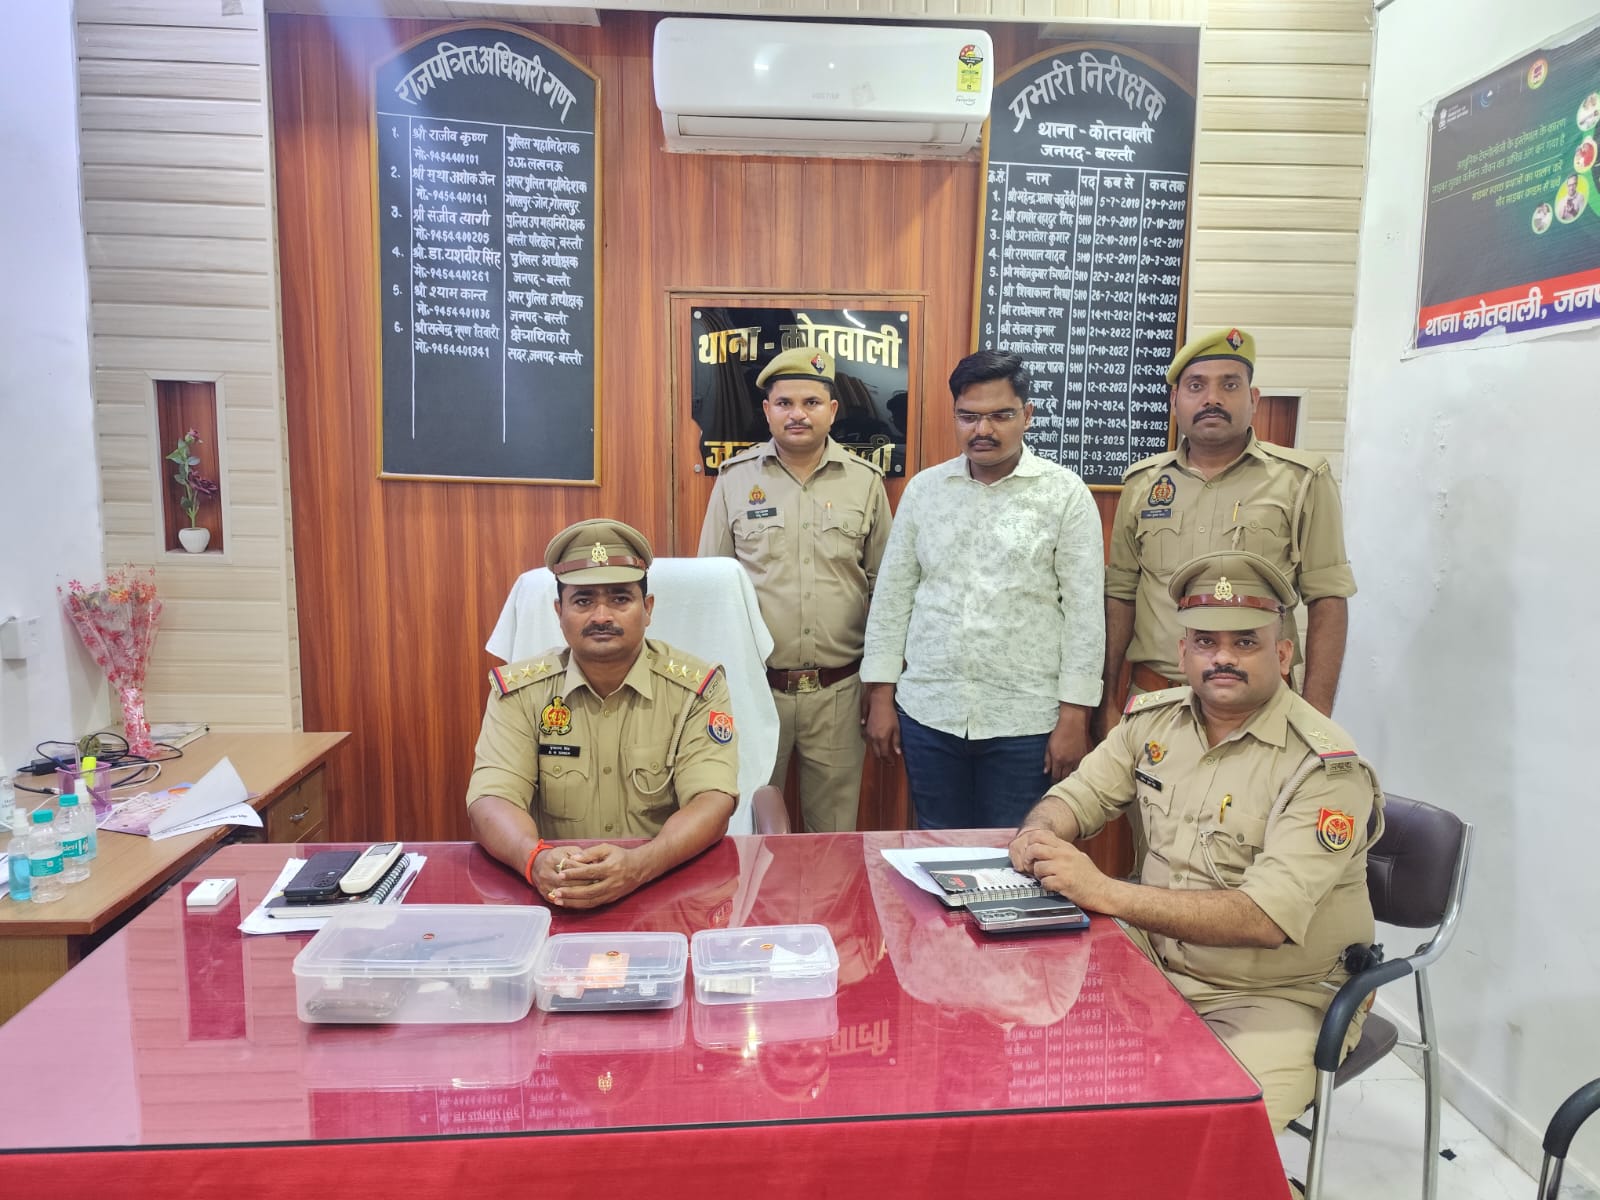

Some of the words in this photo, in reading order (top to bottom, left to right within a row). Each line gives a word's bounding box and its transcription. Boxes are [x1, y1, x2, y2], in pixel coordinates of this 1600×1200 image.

[394, 42, 478, 104] राजपत्रित
[478, 42, 546, 96] अधिकारी
[543, 72, 576, 124] गण
[1008, 59, 1074, 133] प्रभारी
[1078, 52, 1166, 122] निरीक्षक
[412, 124, 426, 141] श्री
[429, 126, 458, 142] राजीव
[460, 132, 489, 146] कृष्ण
[1038, 120, 1078, 140] थाना
[1089, 120, 1155, 144] कोतवाली
[506, 133, 532, 152] पुलिस
[533, 136, 580, 155] महानिदेशक
[1041, 143, 1086, 162] जनपद
[1094, 145, 1136, 162] बस्ती
[391, 166, 400, 178] 2.
[412, 164, 426, 180] श्री
[450, 169, 478, 185] अशोक
[479, 170, 496, 186] जैन
[528, 158, 564, 172] लखनऊ
[1026, 172, 1052, 186] नाम
[1080, 176, 1096, 190] पद
[1104, 177, 1122, 188] कब
[1124, 173, 1135, 190] से
[1149, 179, 1169, 192] कब
[1170, 180, 1186, 192] तक
[1008, 187, 1018, 203] श्री
[1080, 195, 1093, 206] SHO
[1100, 196, 1140, 208] 5-7-2018
[1145, 198, 1186, 211] 29-9-2019
[413, 204, 426, 222] श्री
[427, 205, 458, 224] संजीव
[460, 209, 492, 226] त्यागी
[992, 208, 1002, 220] 2.
[1006, 207, 1016, 222] श्री
[1079, 215, 1092, 226] SHO
[1097, 215, 1138, 228] 29-9-2019
[990, 228, 1000, 240] 3.
[1006, 226, 1018, 242] श्री
[1048, 232, 1071, 246] कुमार
[1078, 234, 1092, 244] SHO
[1143, 236, 1184, 248] 6-12-2019
[392, 246, 404, 258] 4.
[482, 247, 502, 270] सिंह
[510, 250, 540, 268] पुलिस
[988, 248, 1000, 260] 4.
[1004, 244, 1016, 260] श्री
[1076, 253, 1090, 263] SHO
[1094, 253, 1136, 265] 15-12-2019
[1140, 254, 1180, 267] 20-3-2021
[989, 266, 998, 278] 5.
[1003, 264, 1013, 278] श्री
[1075, 270, 1088, 280] SHO
[1093, 271, 1134, 284] 22-3-2021
[1139, 274, 1180, 286] 26-7-2021
[393, 284, 402, 296] 5.
[414, 281, 428, 298] श्री
[428, 286, 458, 299] श्याम
[460, 288, 488, 302] कान्त
[988, 284, 997, 296] 6.
[1002, 282, 1014, 298] श्री
[1074, 289, 1088, 300] SHO
[1092, 290, 1133, 304] 26-7-2021
[1138, 292, 1178, 306] 14-11-2021
[987, 304, 995, 316] 7.
[1002, 302, 1012, 316] श्री
[1048, 306, 1064, 318] राय
[1072, 308, 1086, 318] SHO
[1091, 309, 1132, 320] 14-11-2021
[1136, 311, 1176, 323] 21-4-2022
[394, 320, 404, 332] 6.
[986, 322, 994, 334] 8.
[1000, 320, 1012, 335] श्री
[1034, 325, 1056, 339] कुमार
[1072, 326, 1086, 336] SHO
[1090, 326, 1131, 338] 21-4-2022
[1425, 312, 1460, 336] थाना
[698, 326, 761, 364] थाना
[779, 313, 902, 368] कोतवाली
[1070, 344, 1084, 354] SHO
[1088, 344, 1128, 356] 17-10-2022
[1136, 347, 1171, 358] 1-7-2023
[1070, 363, 1083, 374] SHO
[1088, 362, 1126, 374] 1-7-2023
[1068, 382, 1082, 392] SHO
[1088, 382, 1128, 392] 12-12-2023
[1132, 384, 1168, 394] 9-3-2024
[1067, 400, 1081, 410] SHO
[1086, 400, 1125, 412] 9-3-2024
[1131, 401, 1168, 414] 20-9-2024
[1066, 417, 1079, 428] SHO
[1085, 416, 1128, 429] 20-9-2024
[1132, 420, 1168, 431] 20-6-2025
[1064, 434, 1080, 444] SHO
[1132, 436, 1166, 447] 18-2-2026
[1063, 450, 1079, 460] SHO
